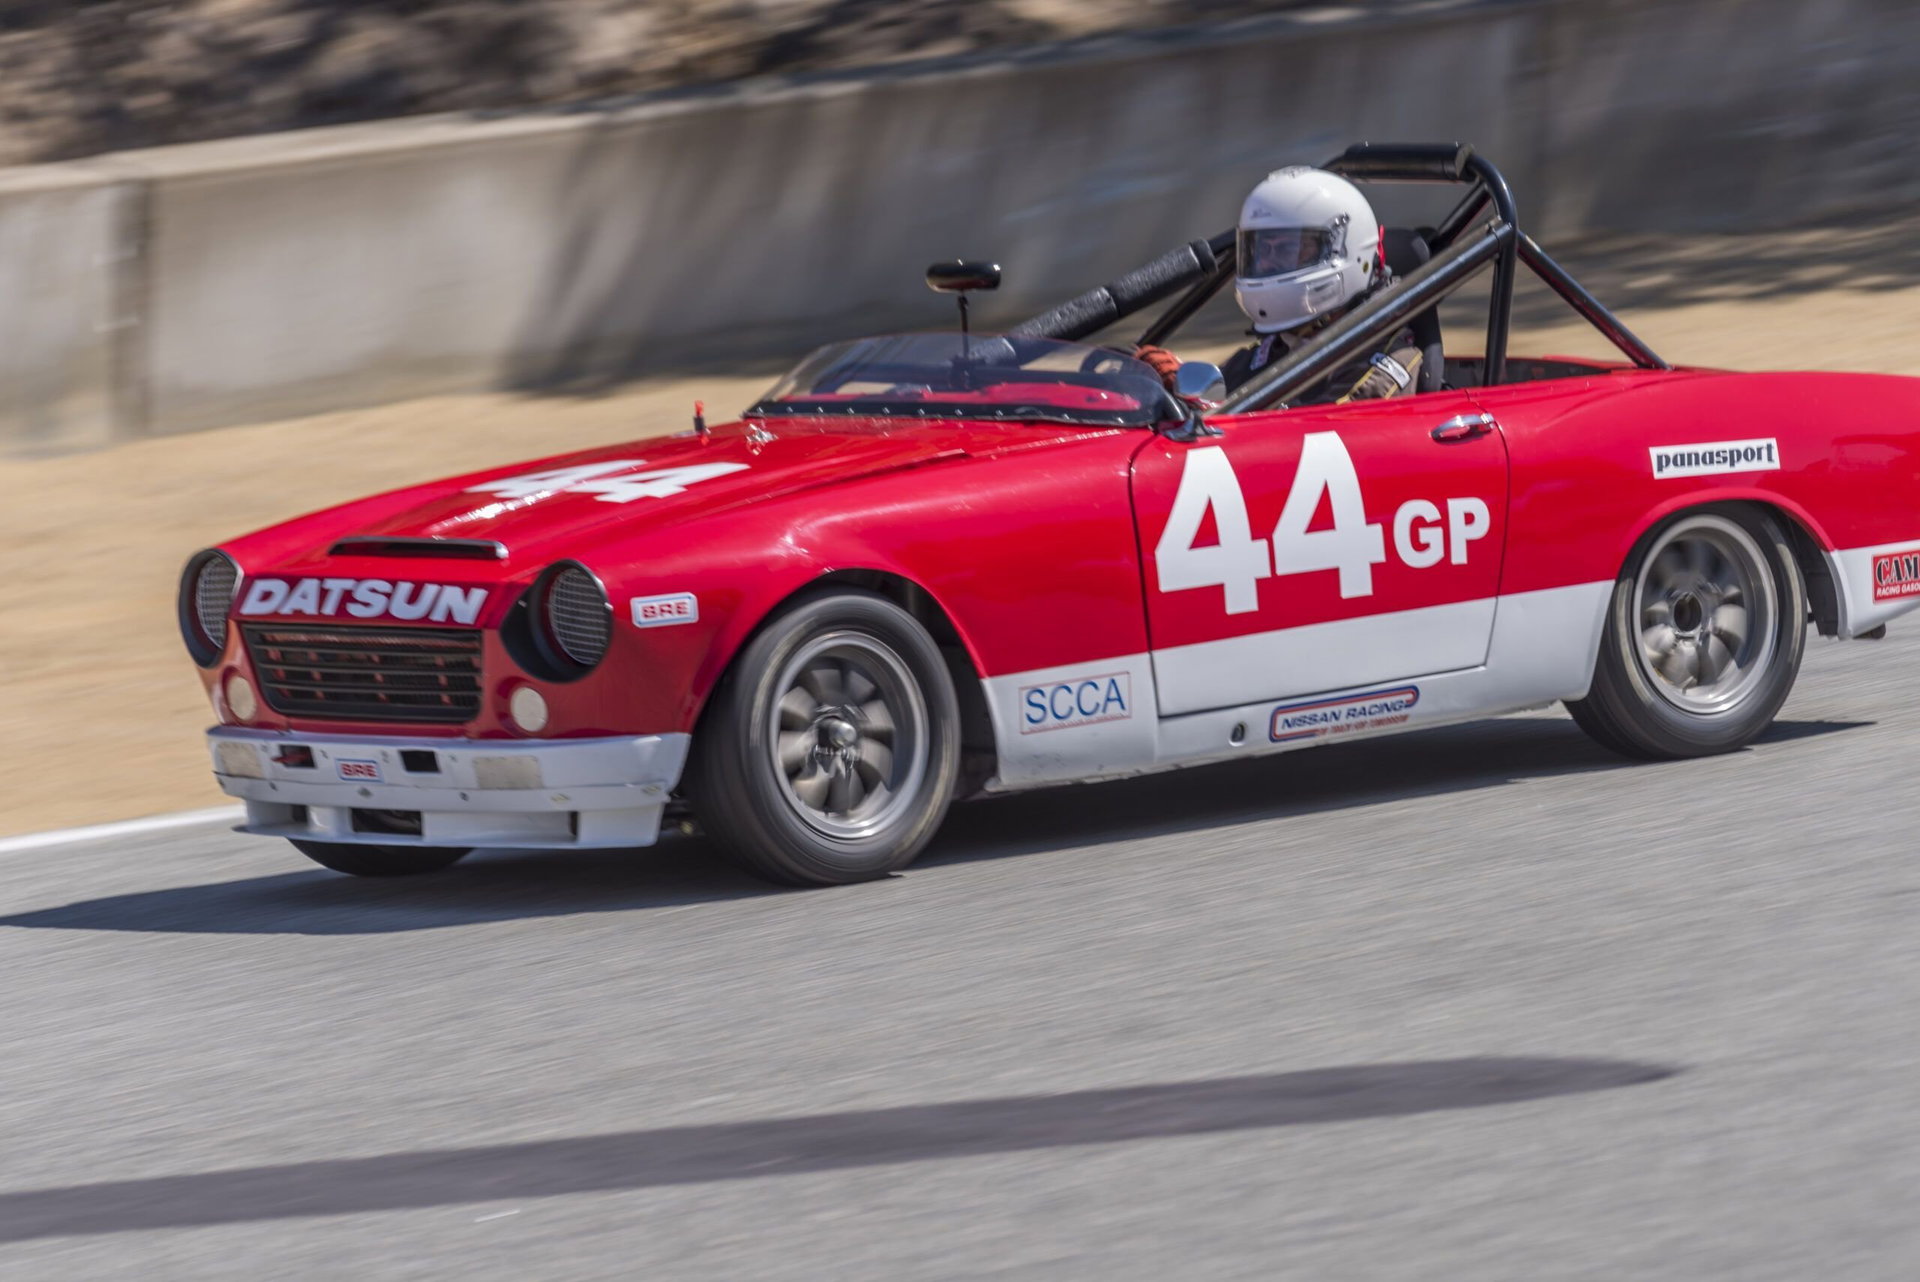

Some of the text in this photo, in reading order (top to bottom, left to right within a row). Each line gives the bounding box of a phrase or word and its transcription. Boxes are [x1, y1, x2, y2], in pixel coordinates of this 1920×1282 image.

[1656, 443, 1775, 473] panasport
[1155, 430, 1490, 615] 44 GP
[239, 578, 489, 625] DATSUN
[1877, 585, 1900, 597] RACING
[642, 602, 688, 618] BRE
[1026, 678, 1125, 724] SCCA
[1282, 710, 1341, 729] NISSAN
[1345, 701, 1404, 719] RACING
[341, 763, 377, 777] BRE
